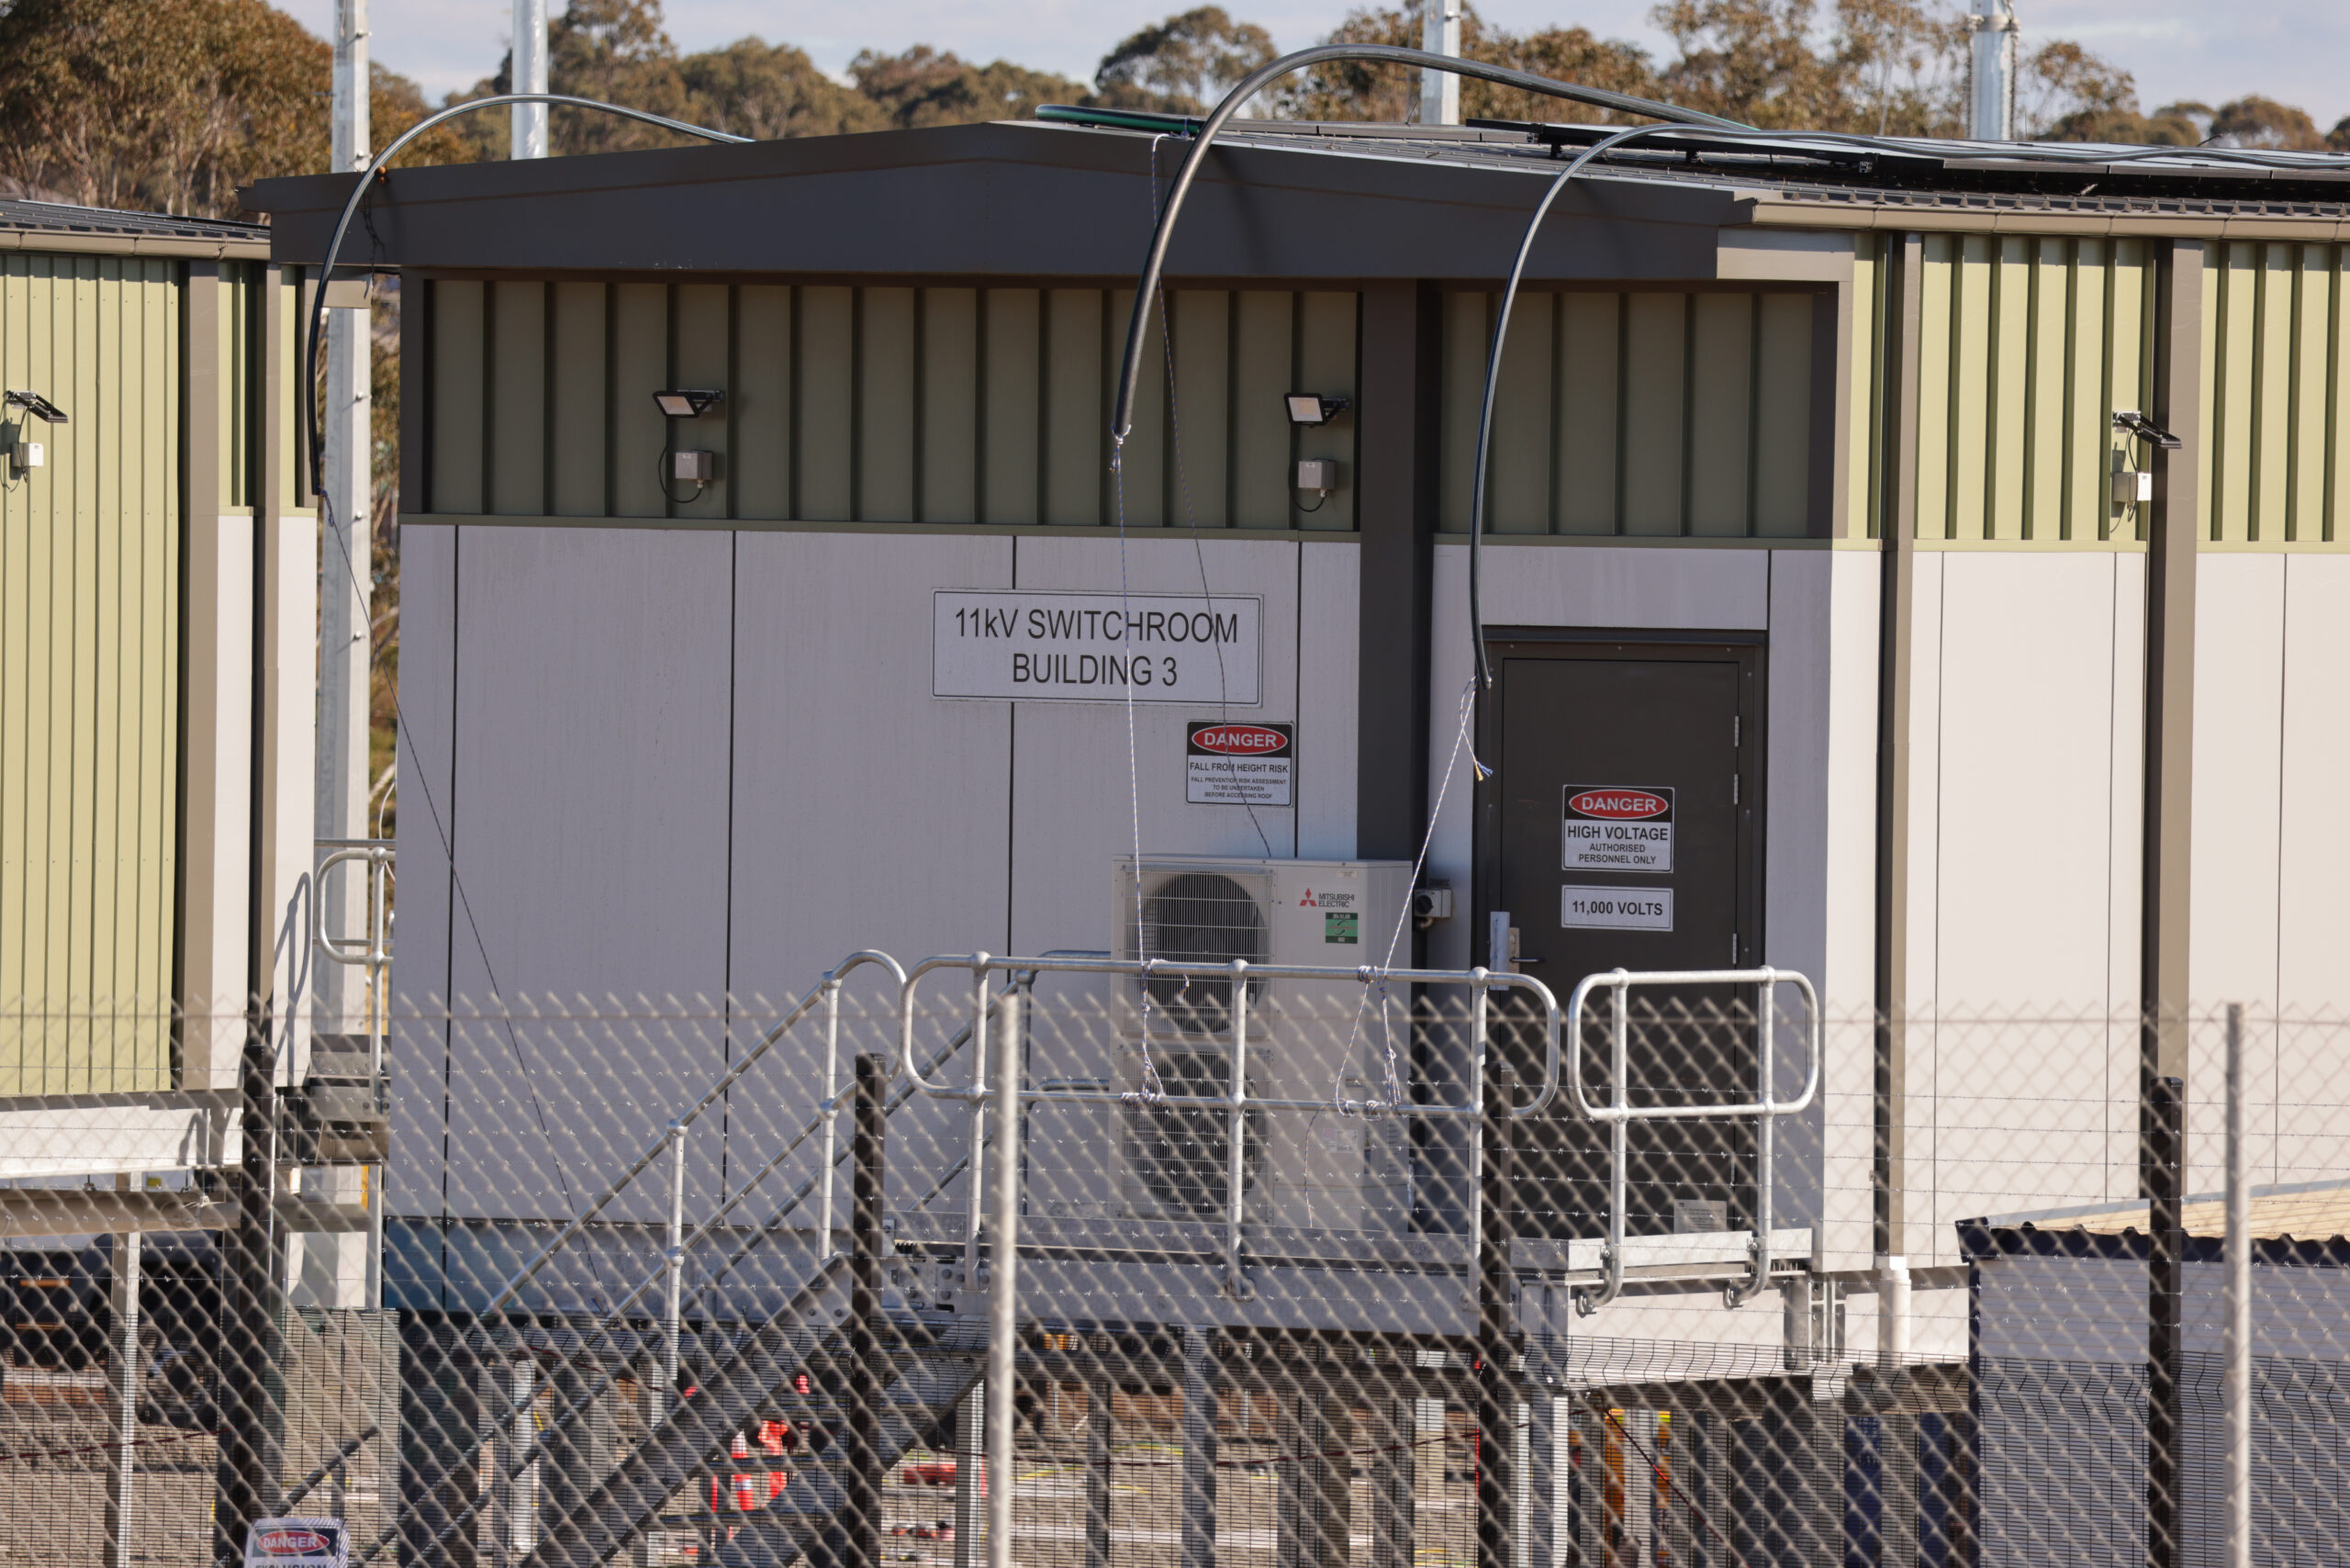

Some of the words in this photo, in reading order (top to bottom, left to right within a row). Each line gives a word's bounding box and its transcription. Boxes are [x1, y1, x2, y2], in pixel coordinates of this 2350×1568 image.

[956, 607, 1018, 639] 11kV
[1027, 609, 1238, 644] SWITCHROOM
[1013, 653, 1152, 686] BUILDING
[1162, 656, 1178, 687] 3
[1203, 732, 1277, 748] DANGER
[1190, 763, 1209, 771] FALL
[1212, 763, 1235, 771] FROM
[1237, 764, 1268, 773] HEIGHT
[1269, 764, 1289, 774] RISK
[1582, 796, 1657, 812] DANGER
[1567, 824, 1601, 839] HIGH
[1605, 826, 1668, 841] VOLTAGE
[1589, 843, 1645, 853] AUTHORISED
[1578, 854, 1631, 864] PERSONNEL
[1633, 856, 1656, 865] ONLY
[1572, 901, 1614, 916] 11,000
[1617, 902, 1663, 916] VOLTS
[263, 1536, 318, 1549] DANGER
